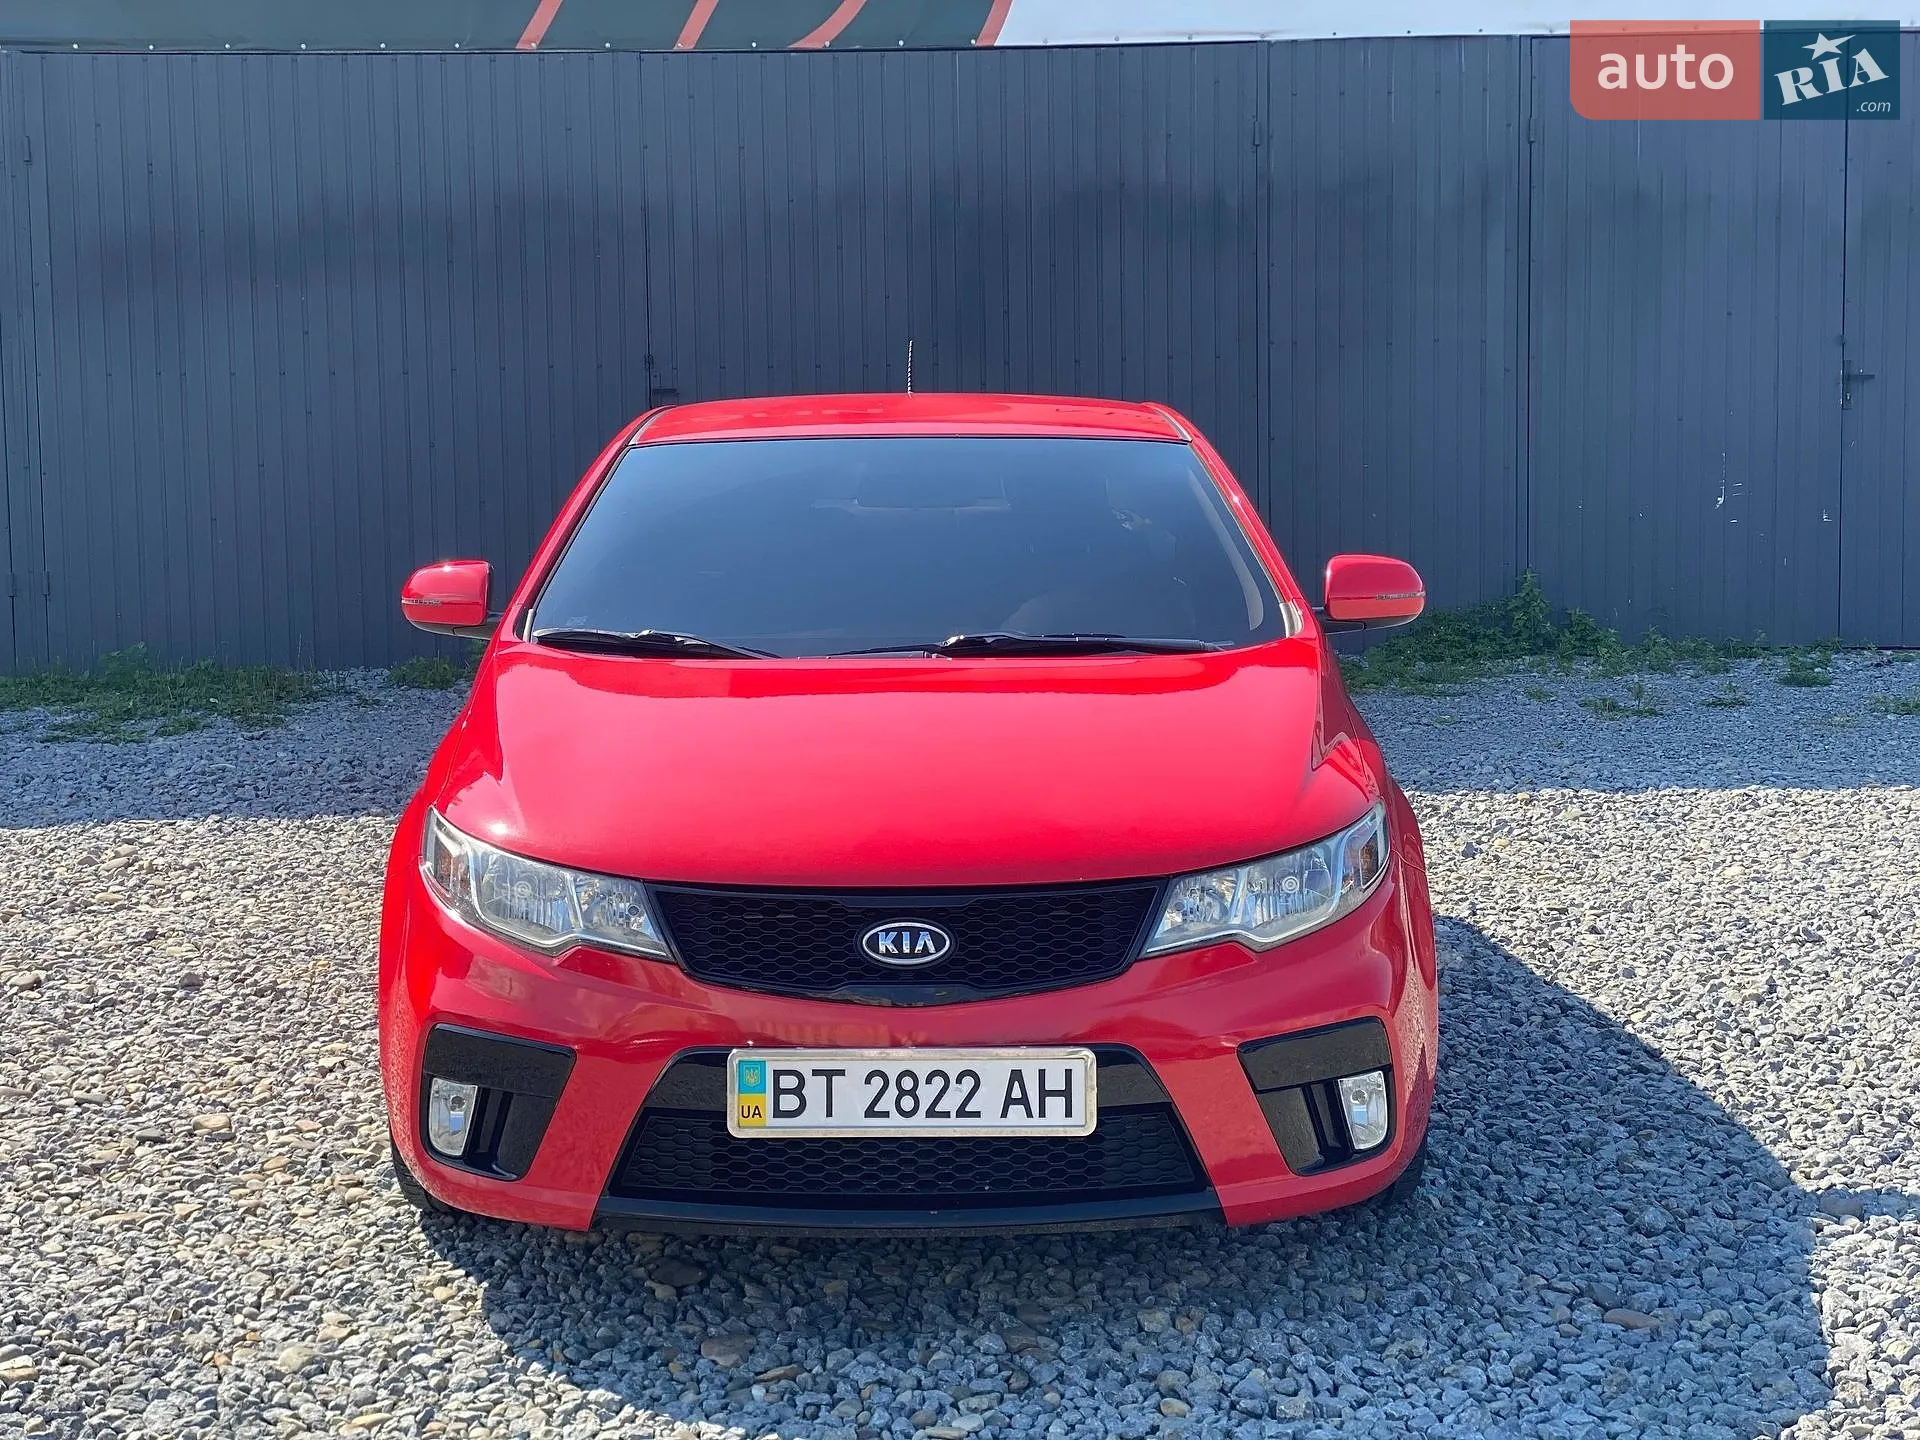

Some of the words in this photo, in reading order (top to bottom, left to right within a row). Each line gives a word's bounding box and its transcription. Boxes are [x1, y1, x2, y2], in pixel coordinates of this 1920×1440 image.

[877, 931, 937, 954] KIA
[771, 1068, 846, 1119] BT
[863, 1068, 982, 1119] 2822
[1000, 1068, 1073, 1119] AH
[740, 1105, 762, 1120] UA
